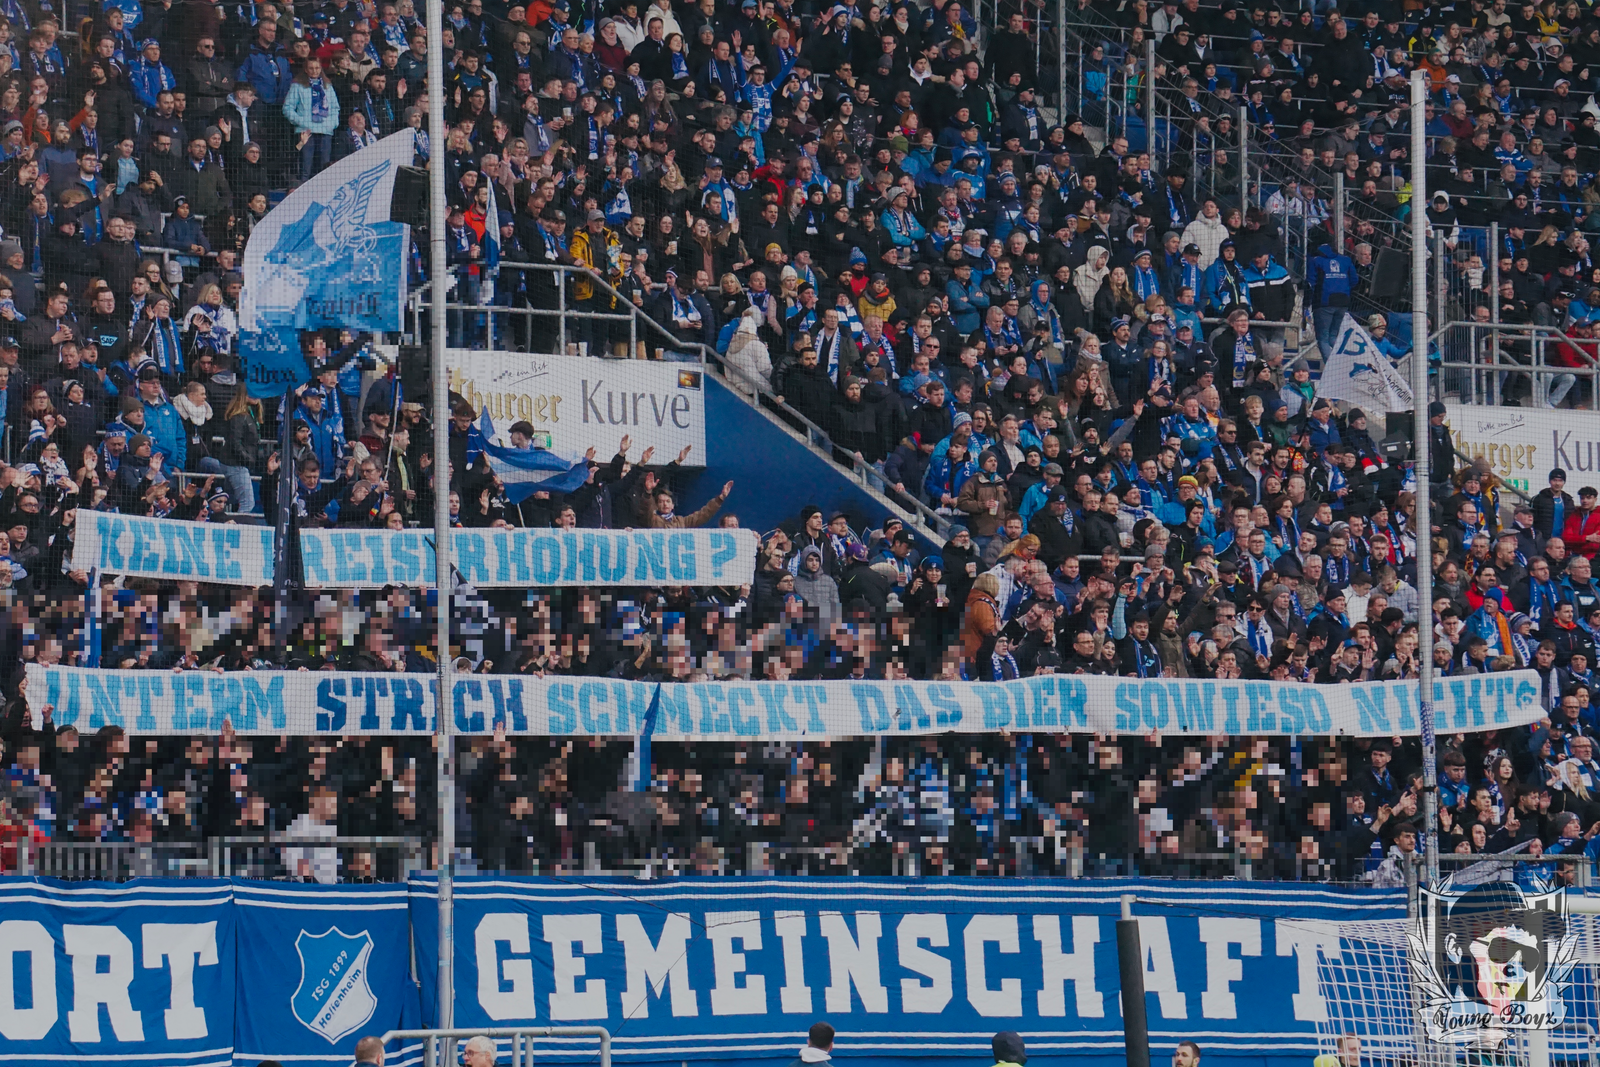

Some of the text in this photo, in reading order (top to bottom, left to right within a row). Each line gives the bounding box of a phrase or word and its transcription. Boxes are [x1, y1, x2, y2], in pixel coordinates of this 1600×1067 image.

[1336, 327, 1368, 356] 13
[449, 367, 691, 429] burger Kurve
[1446, 418, 1600, 478] burger Ku
[96, 515, 243, 580] KEINE
[45, 670, 288, 731] UNTERM
[547, 682, 828, 736] SCHMECKT
[851, 683, 964, 733] DAS
[971, 676, 1089, 730] BIER
[1114, 681, 1333, 734] SOWIESO
[1351, 676, 1514, 733] NICHT
[0, 919, 219, 1043] ORT
[311, 950, 348, 1001] TSG 1899
[474, 912, 1341, 1023] GEMEINSCHAFT
